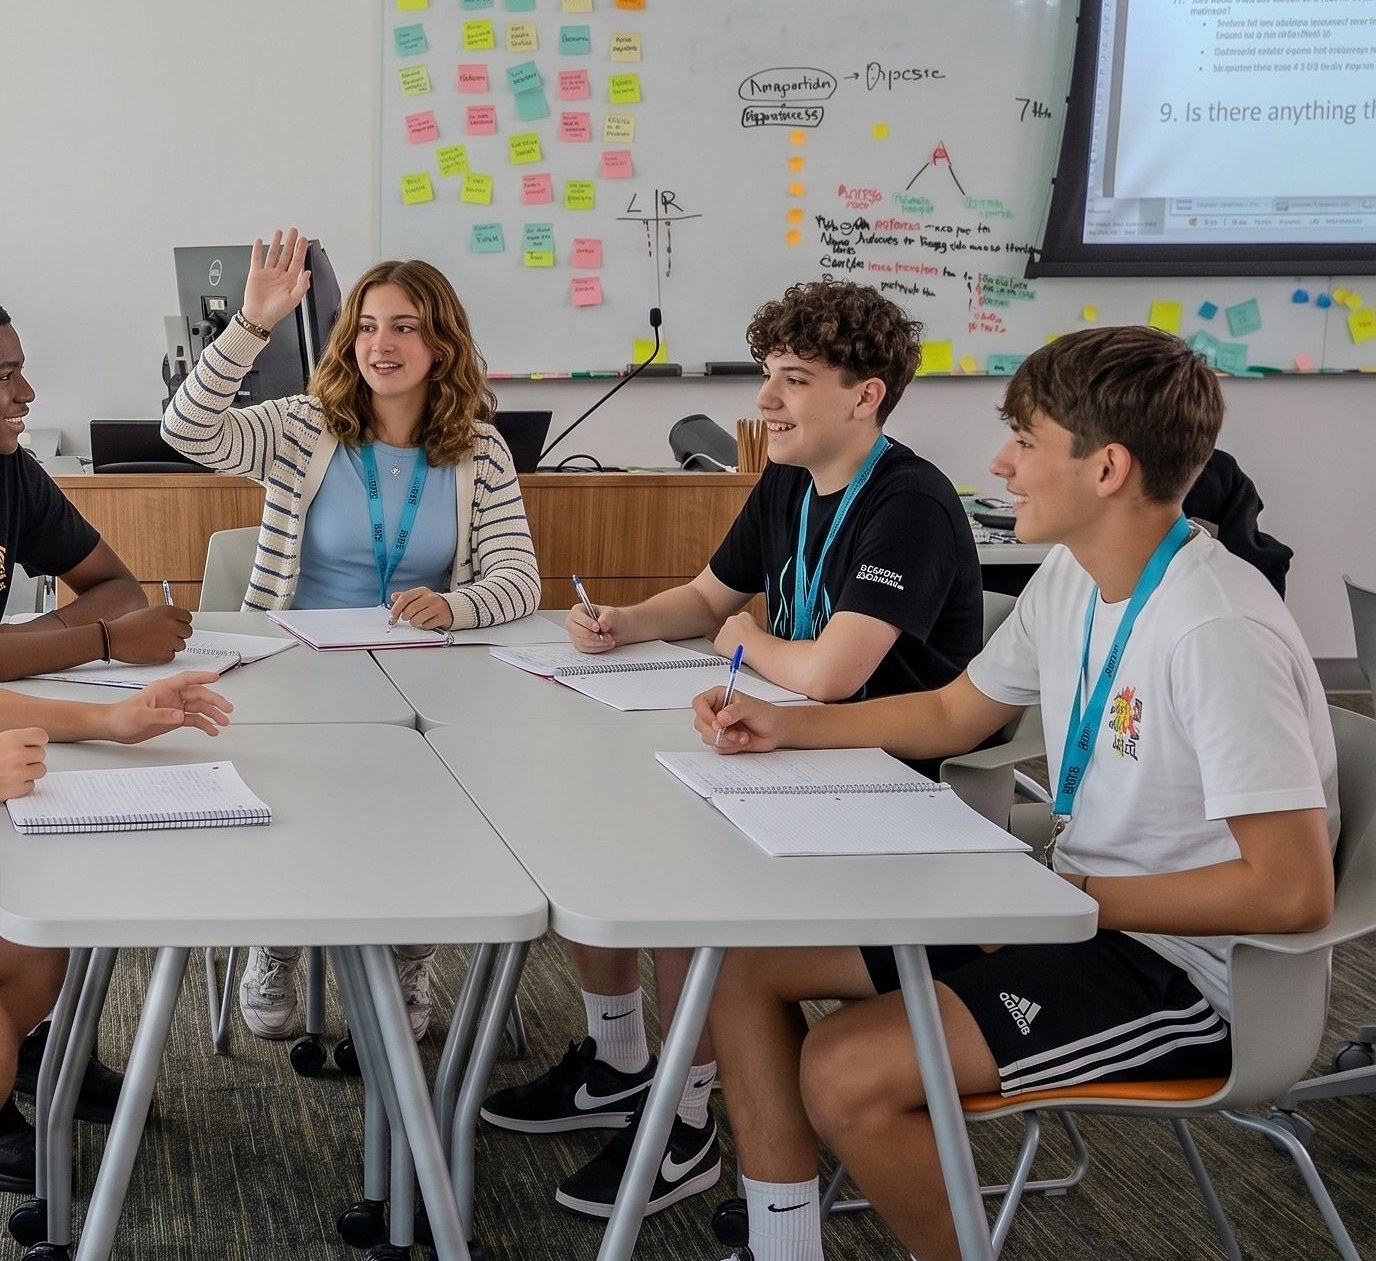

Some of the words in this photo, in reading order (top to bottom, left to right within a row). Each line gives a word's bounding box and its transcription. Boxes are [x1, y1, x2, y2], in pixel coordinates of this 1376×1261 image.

[1160, 103, 1177, 123] 9.
[1186, 102, 1201, 122] Is
[1208, 101, 1262, 122] there
[1268, 100, 1357, 125] anything
[661, 190, 684, 214] R
[999, 992, 1031, 1036] adidas
